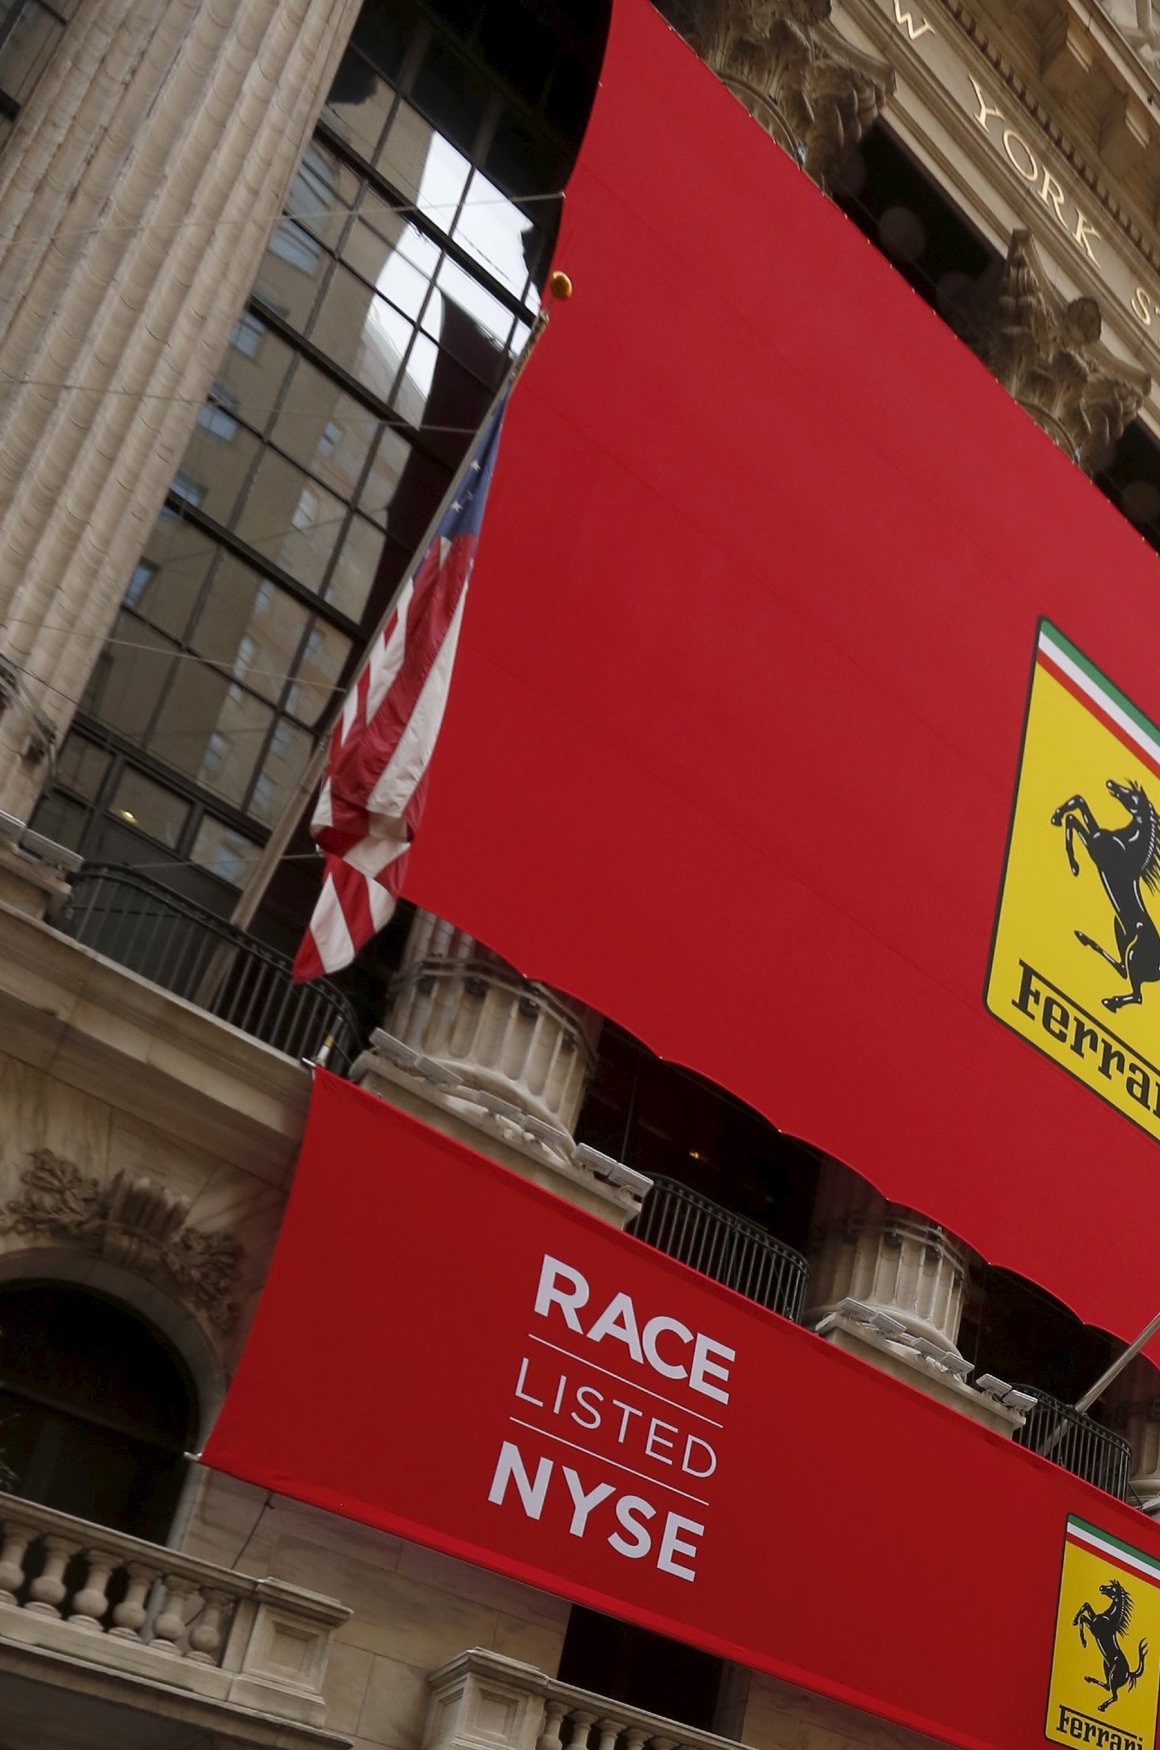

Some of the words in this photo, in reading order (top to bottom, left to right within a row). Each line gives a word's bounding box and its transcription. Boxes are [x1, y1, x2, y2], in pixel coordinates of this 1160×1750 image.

[968, 73, 1101, 270] YORK
[533, 1253, 736, 1405] RACE
[515, 1357, 718, 1478] LISTED
[487, 1440, 705, 1582] NYSE
